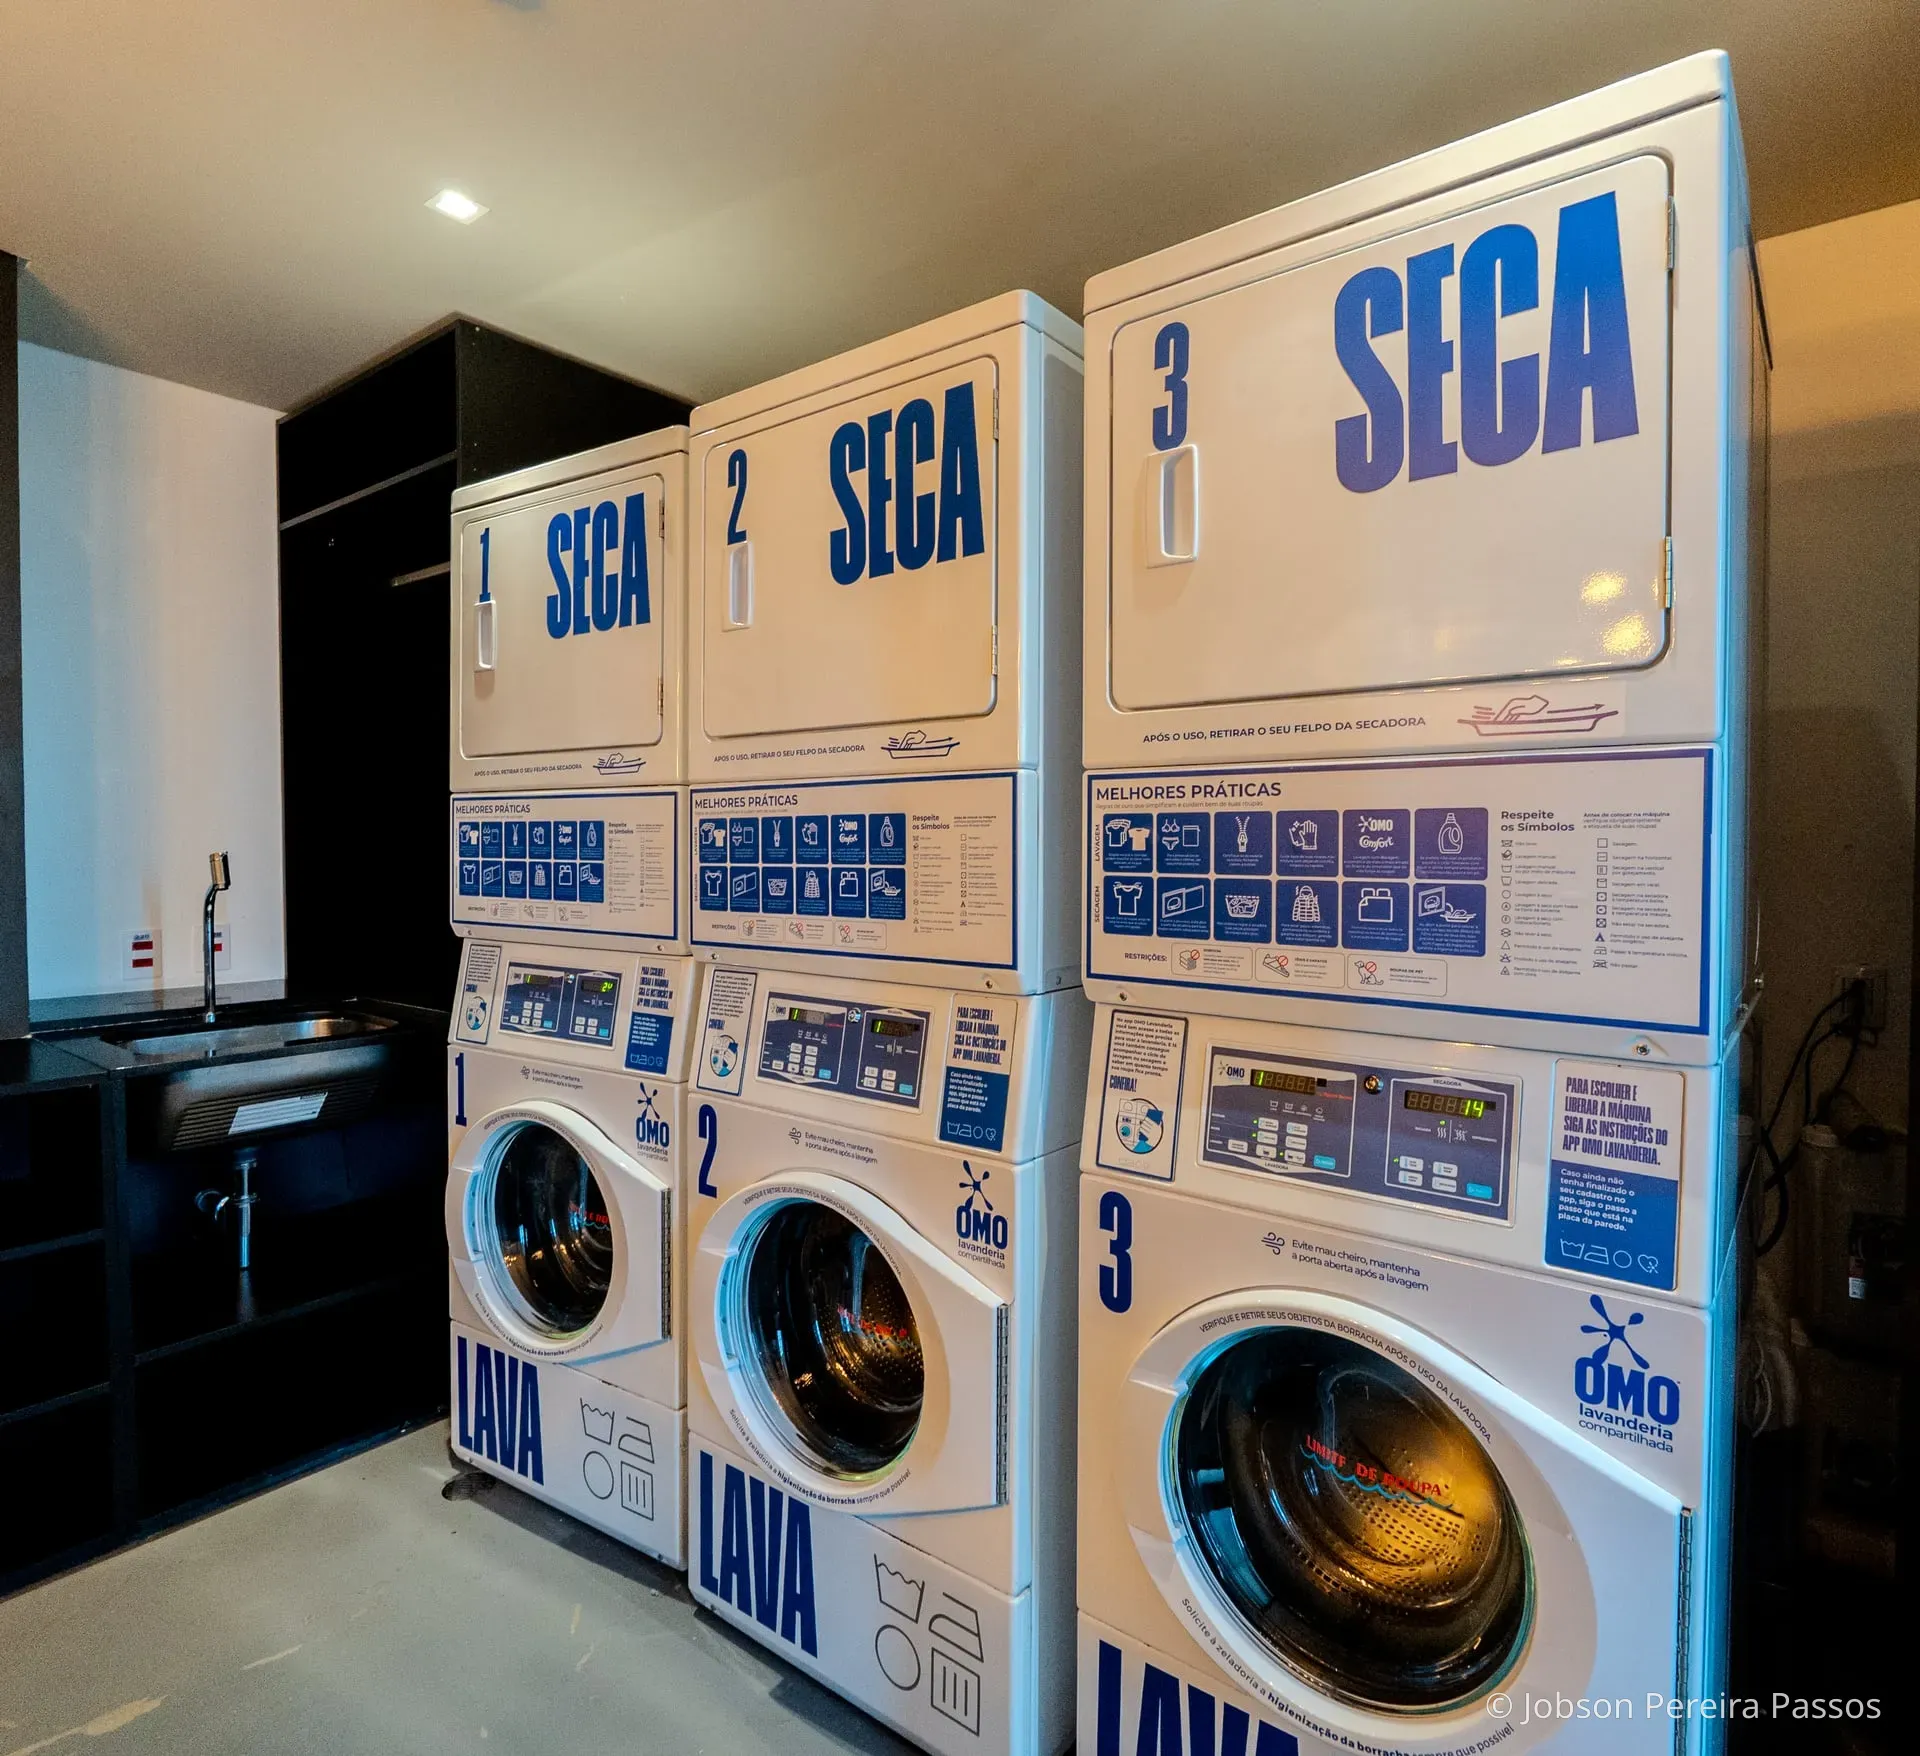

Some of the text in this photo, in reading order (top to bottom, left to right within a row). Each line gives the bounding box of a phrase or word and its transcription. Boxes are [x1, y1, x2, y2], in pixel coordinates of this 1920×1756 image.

[1334, 190, 1639, 493] SECA
[1153, 322, 1189, 451] 3
[829, 381, 985, 586] SECA
[727, 448, 748, 545] 2
[479, 527, 490, 603] 1
[546, 492, 651, 640] SECA
[1143, 717, 1426, 743] APÓS O USO, RETIRAR O SEU FELPO DA SECADORA
[750, 752, 776, 760] RETIRAR
[796, 748, 816, 756] FELPO
[828, 745, 865, 754] SECADORA
[694, 794, 798, 809] MELHORES PRÁTICAS
[1096, 780, 1282, 800] MELHORES PRÁTICAS
[455, 803, 531, 814] MELHORES PRÁTICAS
[912, 814, 940, 822] Respeite
[1501, 810, 1554, 822] Respeite
[920, 822, 950, 830] Símbolos
[1371, 819, 1393, 832] OMO
[1501, 821, 1575, 832] os Símbolos
[1359, 835, 1394, 851] Comfort
[1124, 952, 1168, 963] RESTRIÇÕES:
[1110, 1075, 1137, 1092] CONFIRA!
[1226, 1065, 1245, 1079] OMO
[1432, 1078, 1462, 1088] SECADORA
[455, 1052, 467, 1127] 1
[1566, 1077, 1638, 1101] PARA ESCOLHER E
[1464, 1099, 1484, 1119] 14
[1565, 1095, 1652, 1124] LIBERAR A MÁQUINA
[636, 1115, 670, 1149] OMO
[1563, 1115, 1668, 1146] SIGA AS INSTRUÇÕES DO
[637, 1142, 669, 1156] lavanderia
[698, 1104, 717, 1199] 2
[1562, 1134, 1661, 1166] APP OMO LAVANDERIA.
[1265, 1162, 1289, 1172] LAVADORA
[1561, 1168, 1624, 1185] Caso ainda não
[1560, 1177, 1584, 1187] tenha
[1586, 1181, 1627, 1195] finalizado
[1576, 1190, 1613, 1201] cadastro
[1614, 1196, 1626, 1204] no
[1558, 1204, 1634, 1224] passo que está na
[1559, 1195, 1577, 1205] app,
[1579, 1198, 1596, 1208] siga
[1605, 1204, 1630, 1214] passo
[956, 1205, 1008, 1250] OMO
[1558, 1212, 1627, 1232] placa da parede.
[958, 1238, 1005, 1261] lavanderia
[958, 1250, 1005, 1270] compartilhada
[1099, 1191, 1133, 1314] 3
[1292, 1240, 1420, 1277] Evite mau cheiro, mantenha
[1299, 1253, 1322, 1266] porta
[1324, 1260, 1353, 1273] aberta
[1354, 1267, 1377, 1280] após
[1378, 1273, 1385, 1281] a
[1386, 1273, 1429, 1292] lavagem
[1199, 1311, 1492, 1444] VERIFIQUE E RETIRE SEUS OBJETOS DA BORRACHA APÓS O USO DA LAVADORA.
[1575, 1356, 1680, 1426] OMO
[457, 1335, 545, 1487] LAVA
[1579, 1402, 1673, 1441] lavanderia
[1579, 1419, 1674, 1454] compartilhada
[729, 1408, 746, 1437] Solicite
[748, 1441, 773, 1470] zeladoria
[777, 1471, 817, 1499] higienização
[817, 1494, 826, 1502] da
[826, 1497, 856, 1505] borracha
[856, 1494, 879, 1504] sempre
[879, 1488, 891, 1498] que
[890, 1467, 911, 1492] possível
[1355, 1462, 1377, 1482] DE
[1382, 1472, 1442, 1497] ROUPA
[700, 1449, 818, 1659] LAVA
[1182, 1598, 1211, 1638] Solicite
[1210, 1637, 1217, 1646] à
[1216, 1644, 1259, 1690] zeladoria
[1259, 1686, 1266, 1696] a
[1267, 1691, 1339, 1742] higienização
[1340, 1735, 1356, 1749] da
[1357, 1742, 1409, 1756] borracha
[1455, 1746, 1477, 1756] que
[1477, 1722, 1515, 1752] possível
